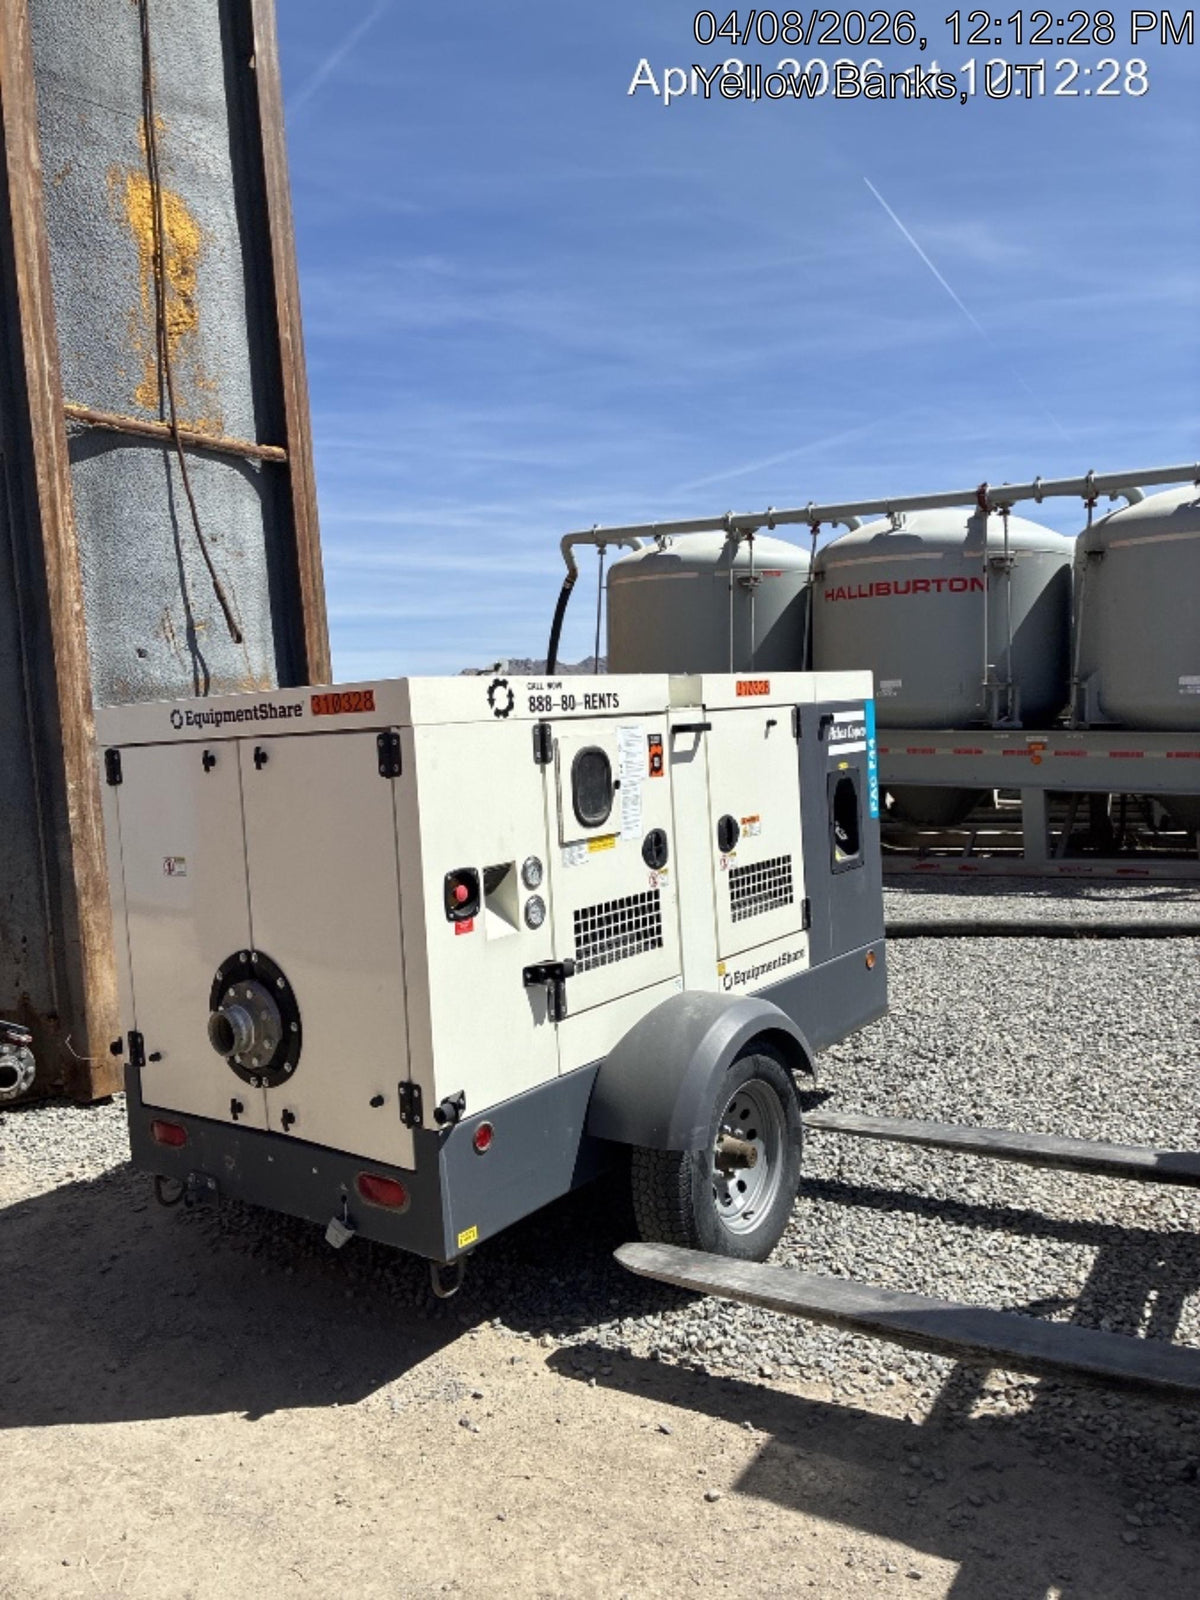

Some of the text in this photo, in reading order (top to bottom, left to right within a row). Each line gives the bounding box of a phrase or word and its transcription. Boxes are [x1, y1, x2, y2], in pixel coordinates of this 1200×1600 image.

[824, 576, 990, 602] HALLIBURTON
[185, 702, 304, 728] EquipmentShare
[311, 690, 375, 715] 310328
[528, 692, 620, 713] 888-80-RENTS
[733, 948, 805, 986] EquipmentShare
